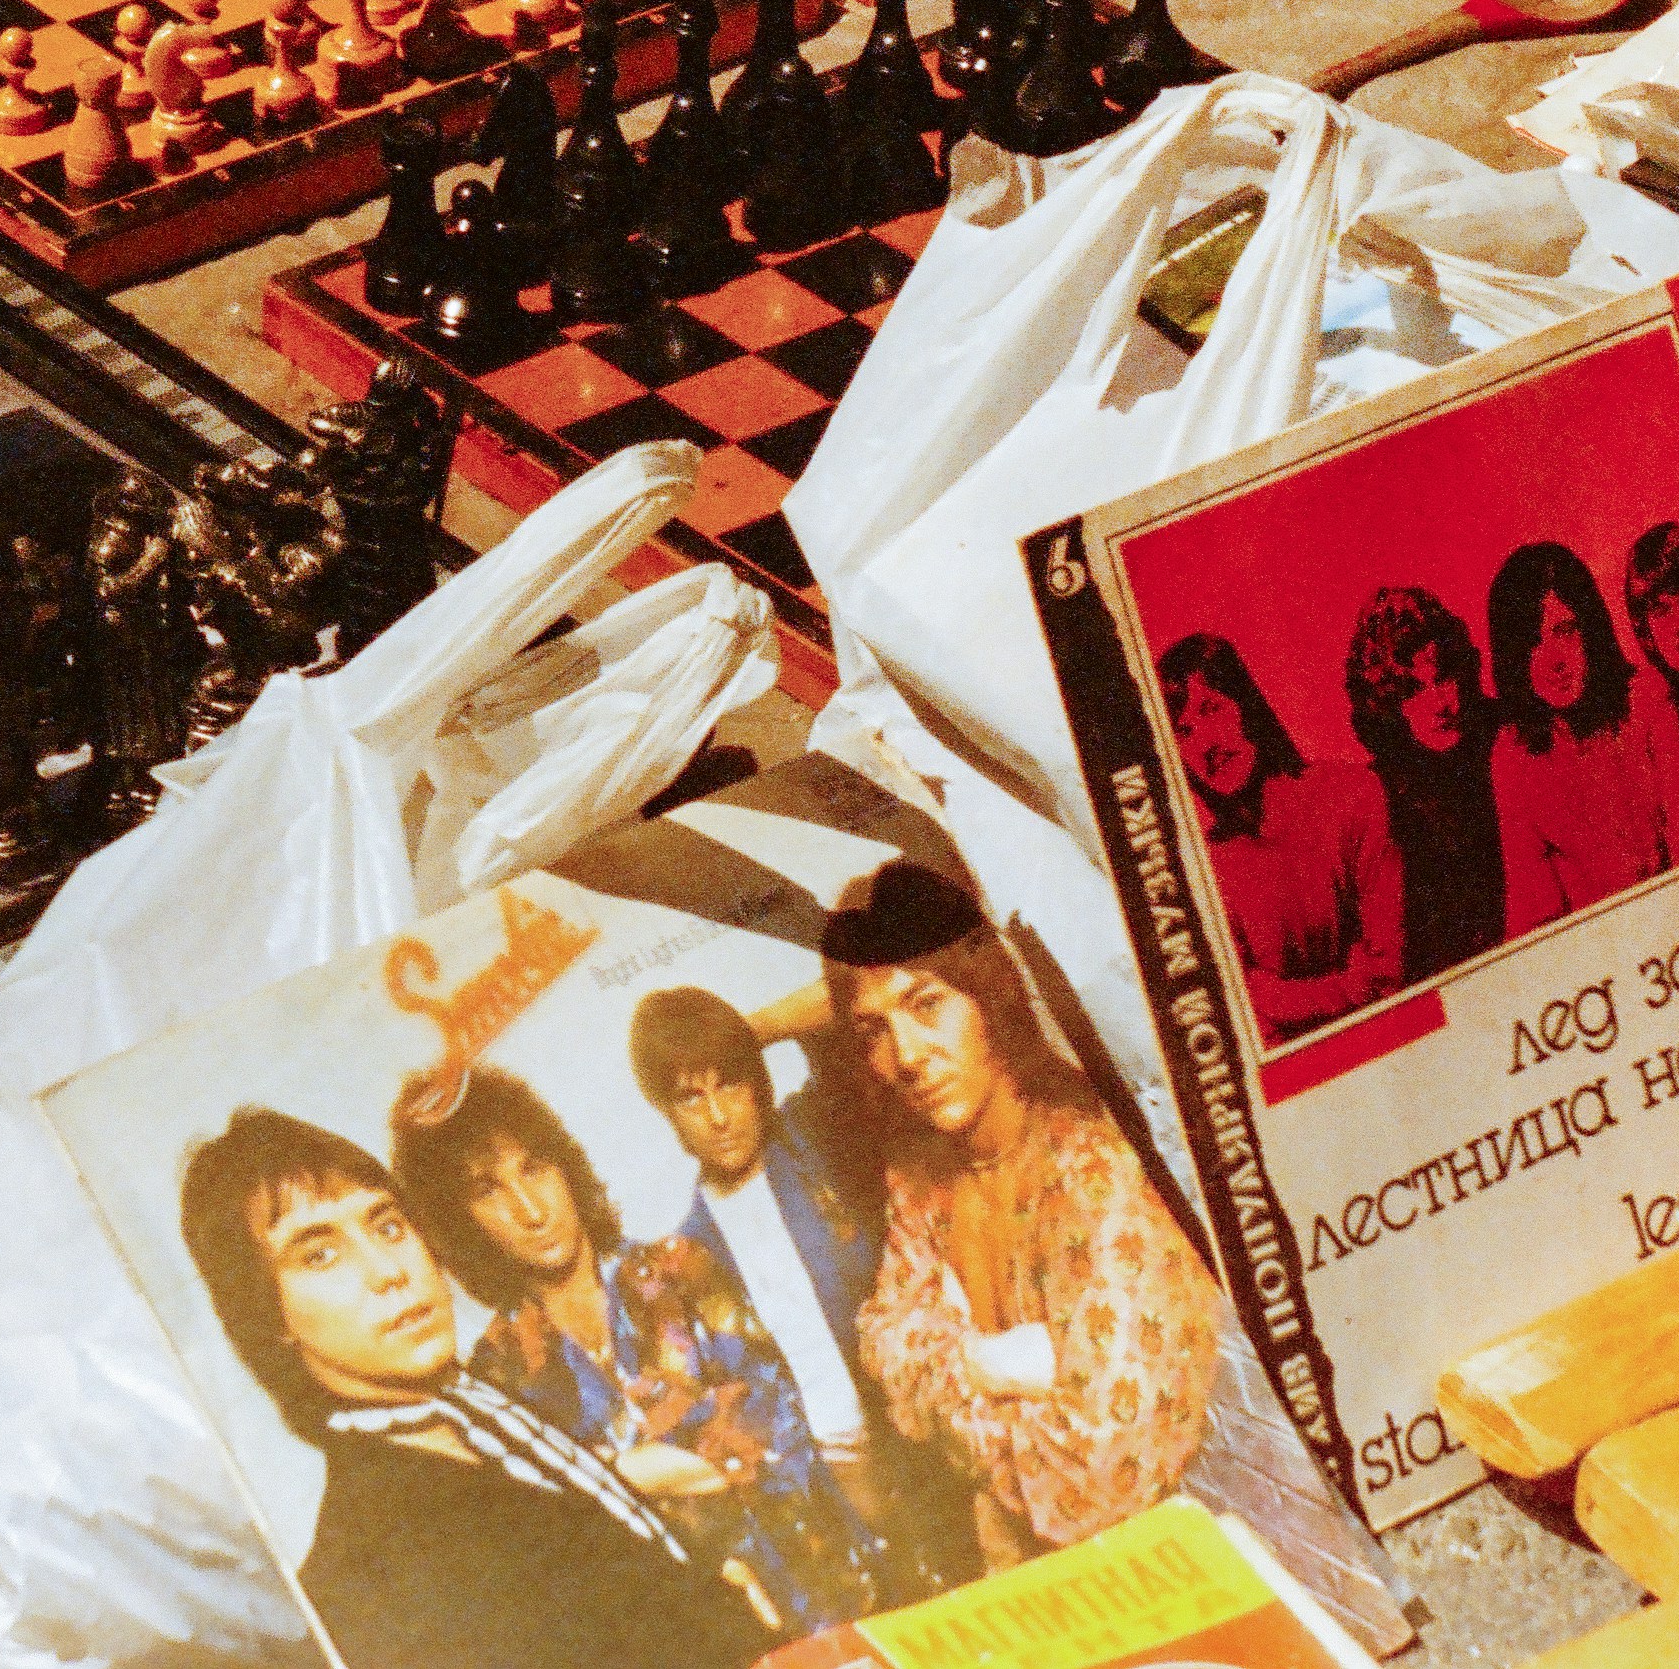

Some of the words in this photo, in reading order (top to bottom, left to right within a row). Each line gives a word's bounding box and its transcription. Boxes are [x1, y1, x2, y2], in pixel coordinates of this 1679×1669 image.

[1046, 534, 1088, 598] 6
[1110, 762, 1199, 975] МУЗЫКИ
[1508, 974, 1620, 1076] лед
[1306, 1078, 1620, 1272] лестница
[1357, 1405, 1466, 1489] sta
